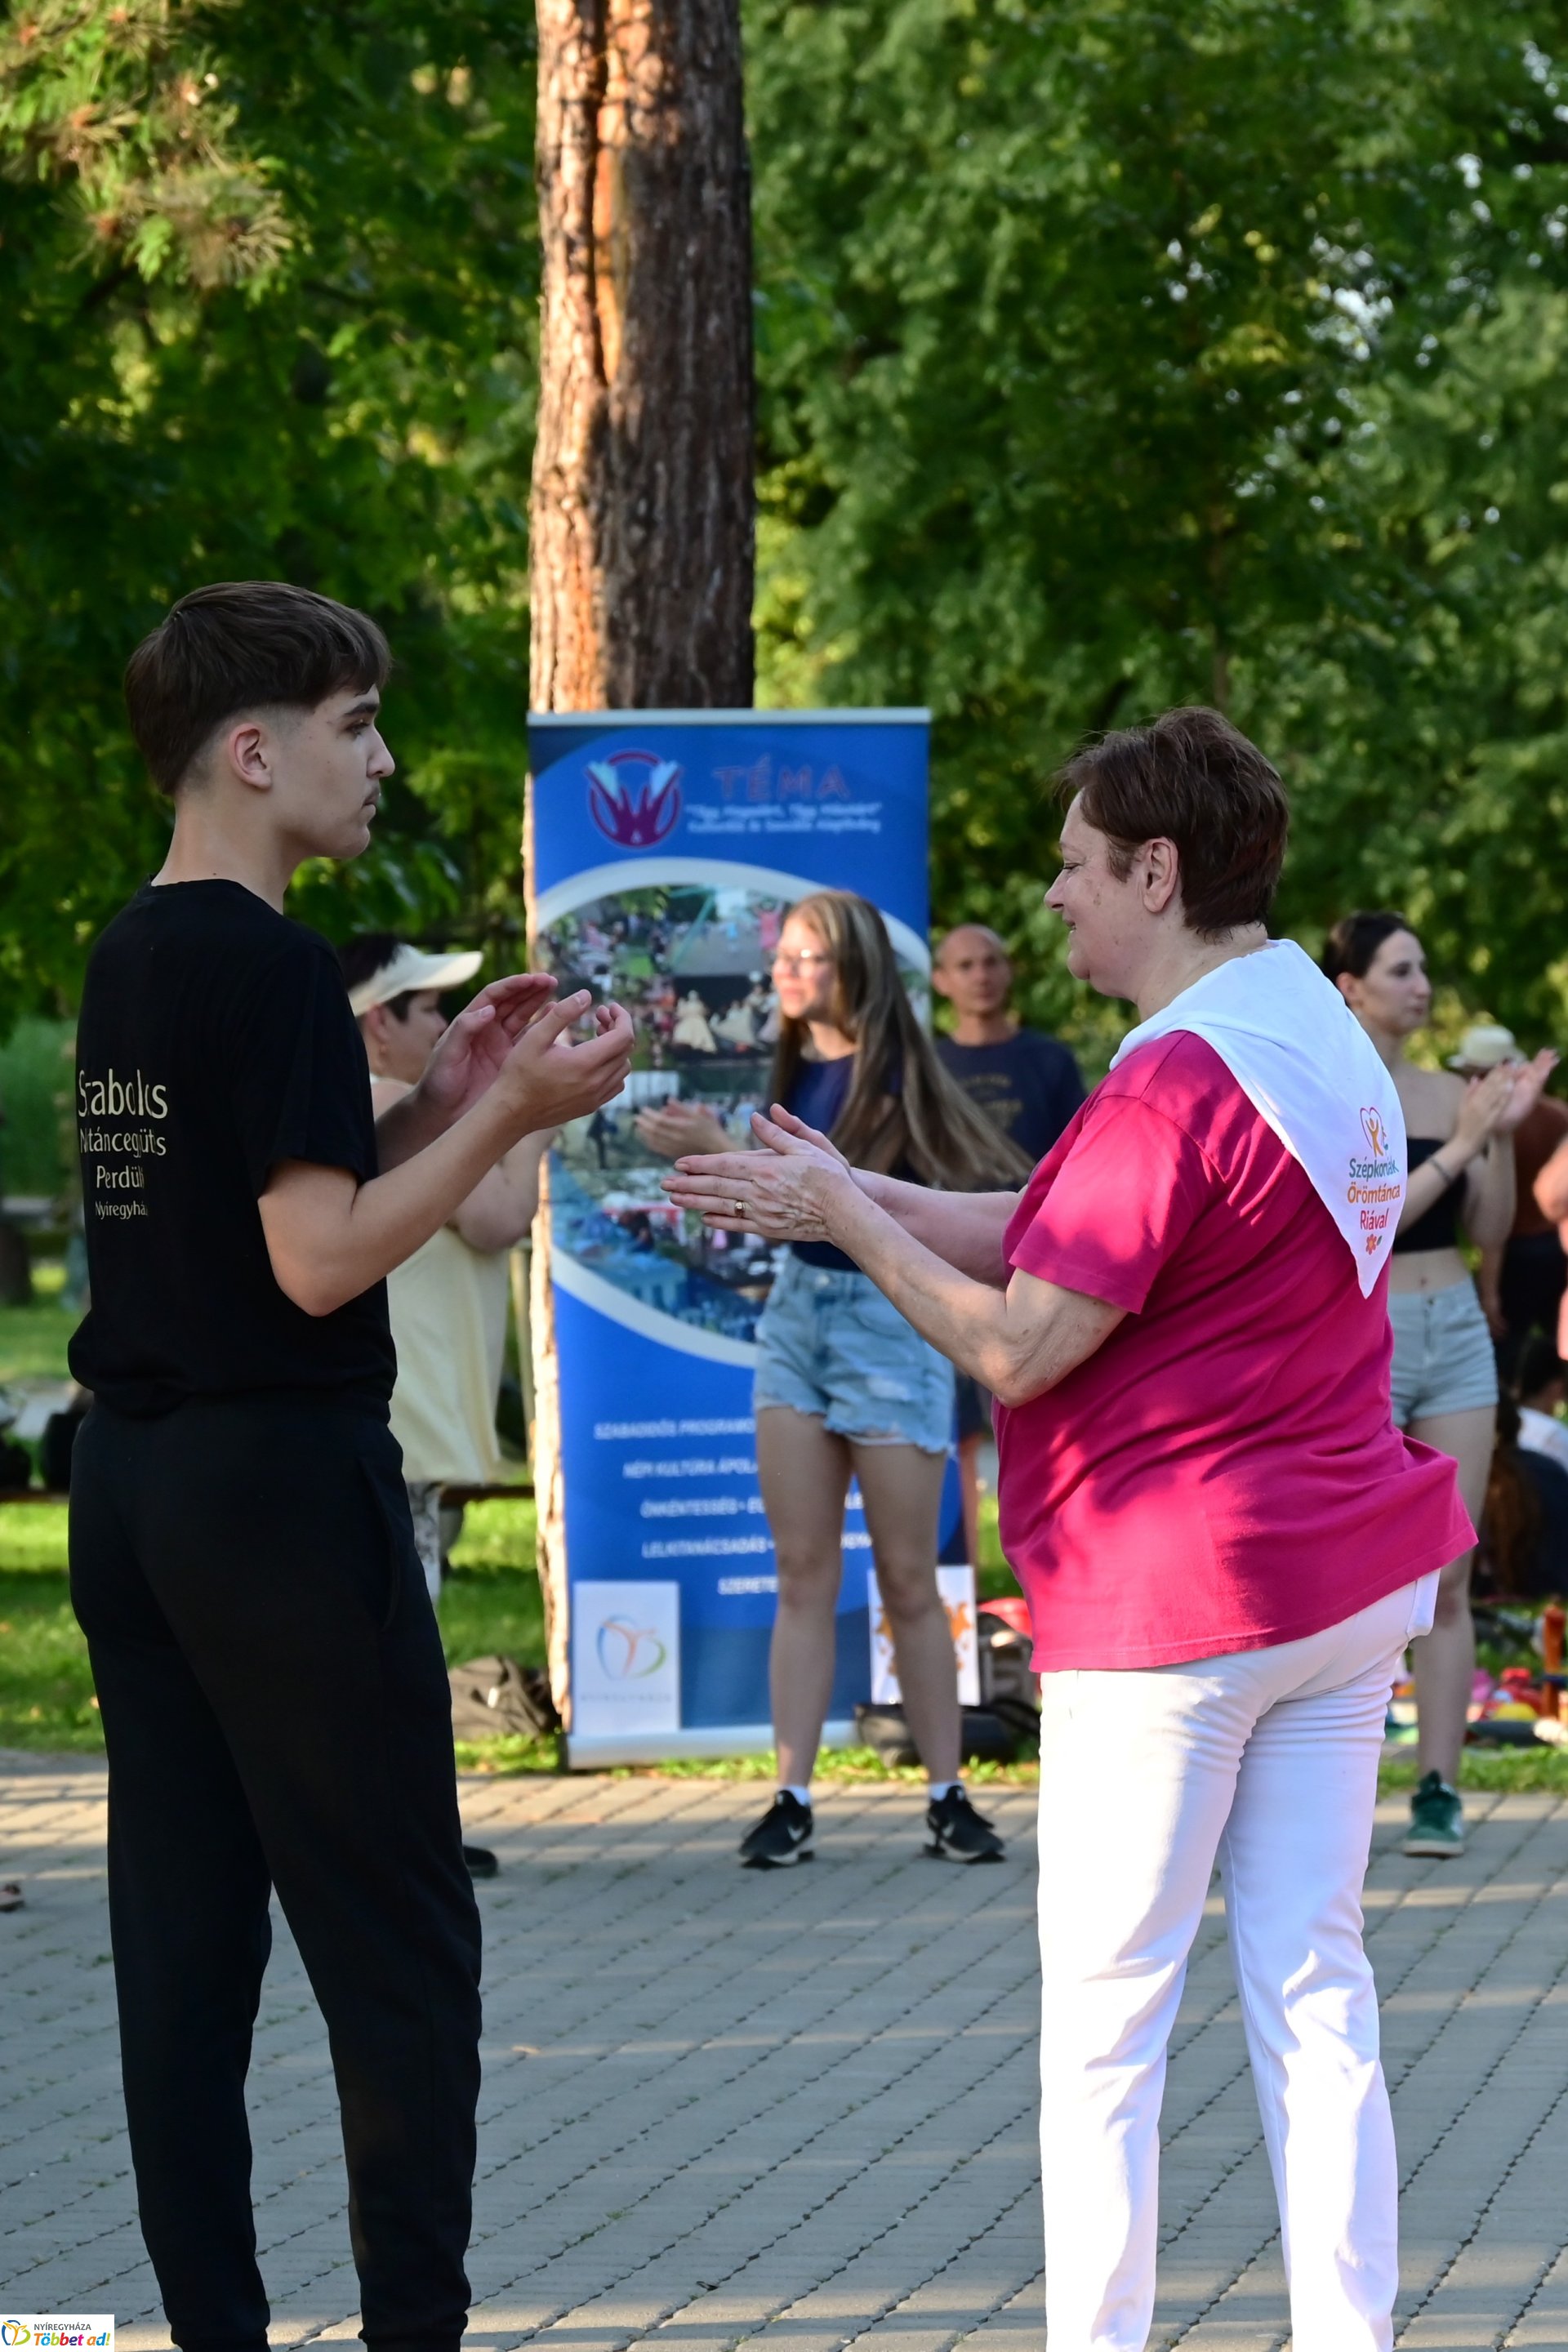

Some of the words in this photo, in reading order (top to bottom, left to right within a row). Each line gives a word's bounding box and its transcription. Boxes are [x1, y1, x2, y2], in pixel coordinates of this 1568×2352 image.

[712, 753, 851, 801] TÉMA
[78, 1068, 168, 1119] Sabolcs
[1347, 1181, 1401, 1204] Örömtánca
[95, 1200, 148, 1220] Nyíregyhá
[1360, 1208, 1390, 1231] Riával
